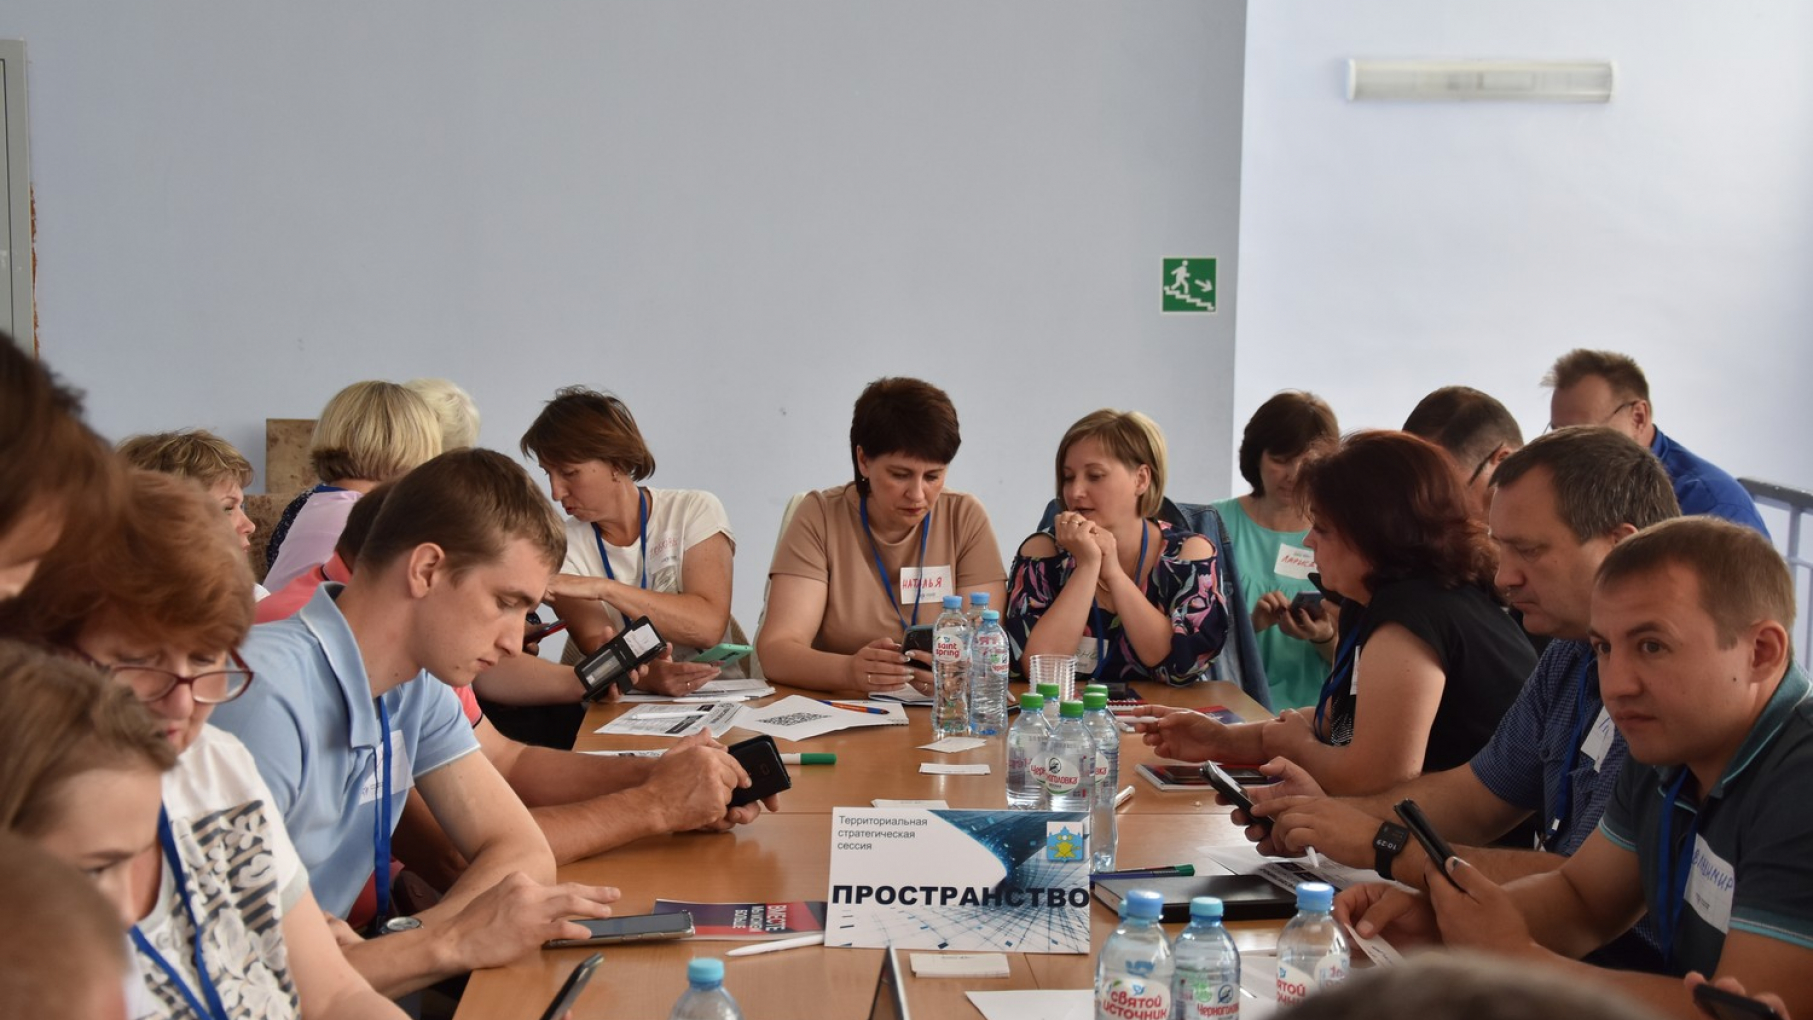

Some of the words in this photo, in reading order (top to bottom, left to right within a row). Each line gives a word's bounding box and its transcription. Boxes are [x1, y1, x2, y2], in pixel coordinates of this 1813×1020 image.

[839, 815, 928, 826] Территориальная
[837, 829, 916, 839] стратегическая
[837, 842, 872, 850] сессия
[832, 885, 1089, 908] ПРОСТРАНСТВО
[1277, 979, 1306, 997] ятой
